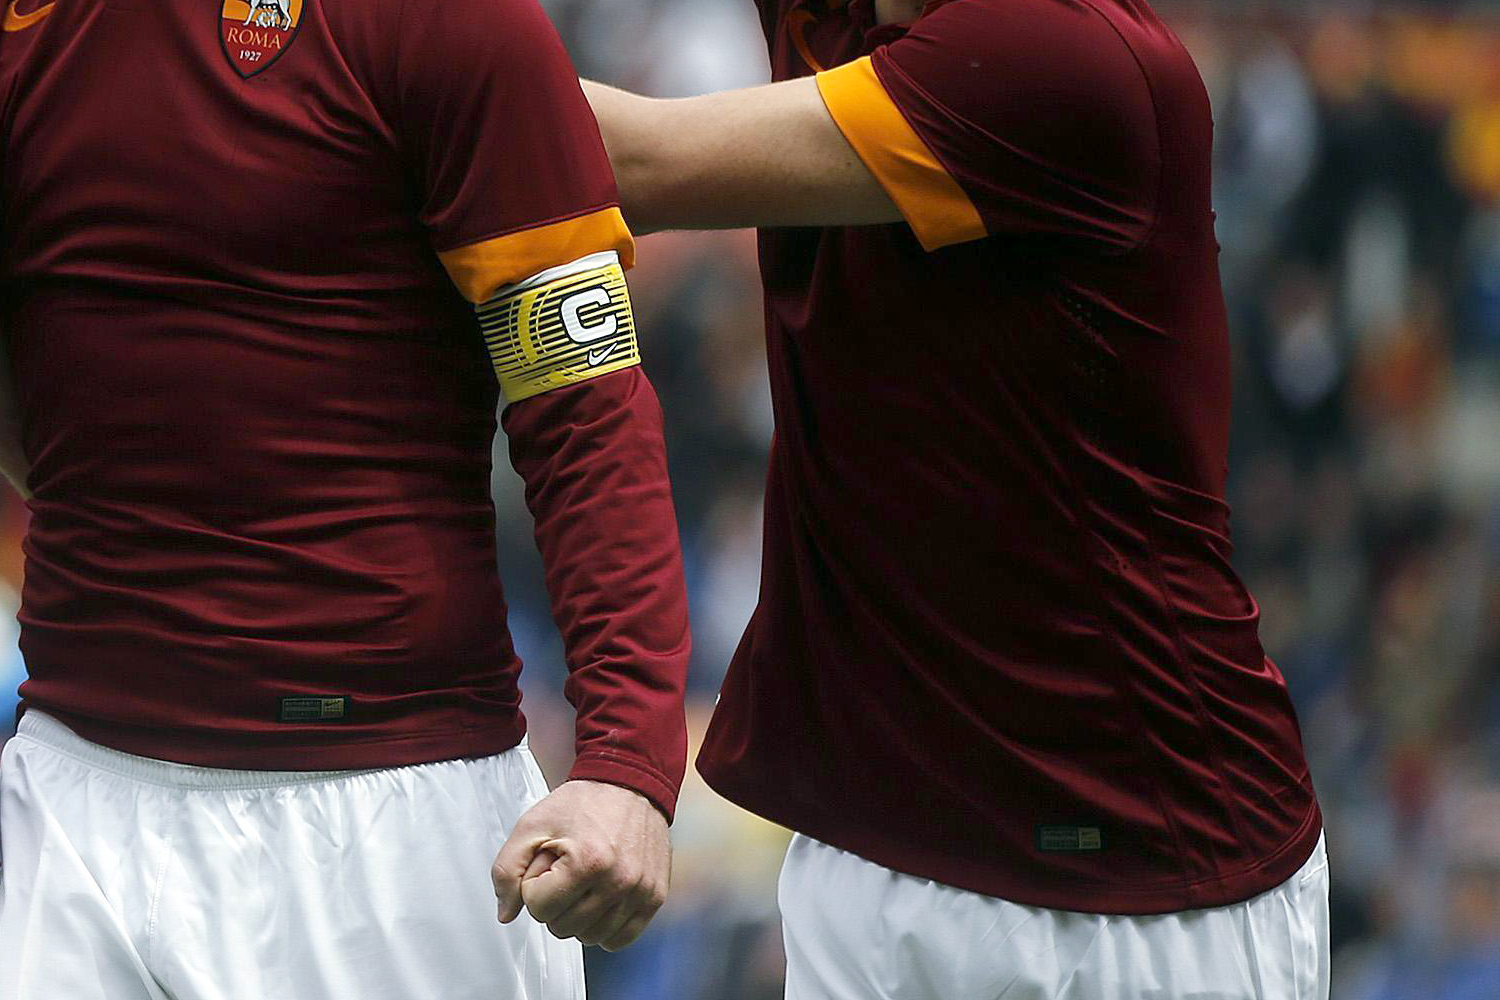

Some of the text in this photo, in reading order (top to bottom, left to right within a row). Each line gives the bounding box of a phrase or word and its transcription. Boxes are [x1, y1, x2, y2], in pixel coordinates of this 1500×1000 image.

[226, 26, 281, 50] ROMA
[239, 49, 262, 62] 1927
[560, 284, 619, 345] C
